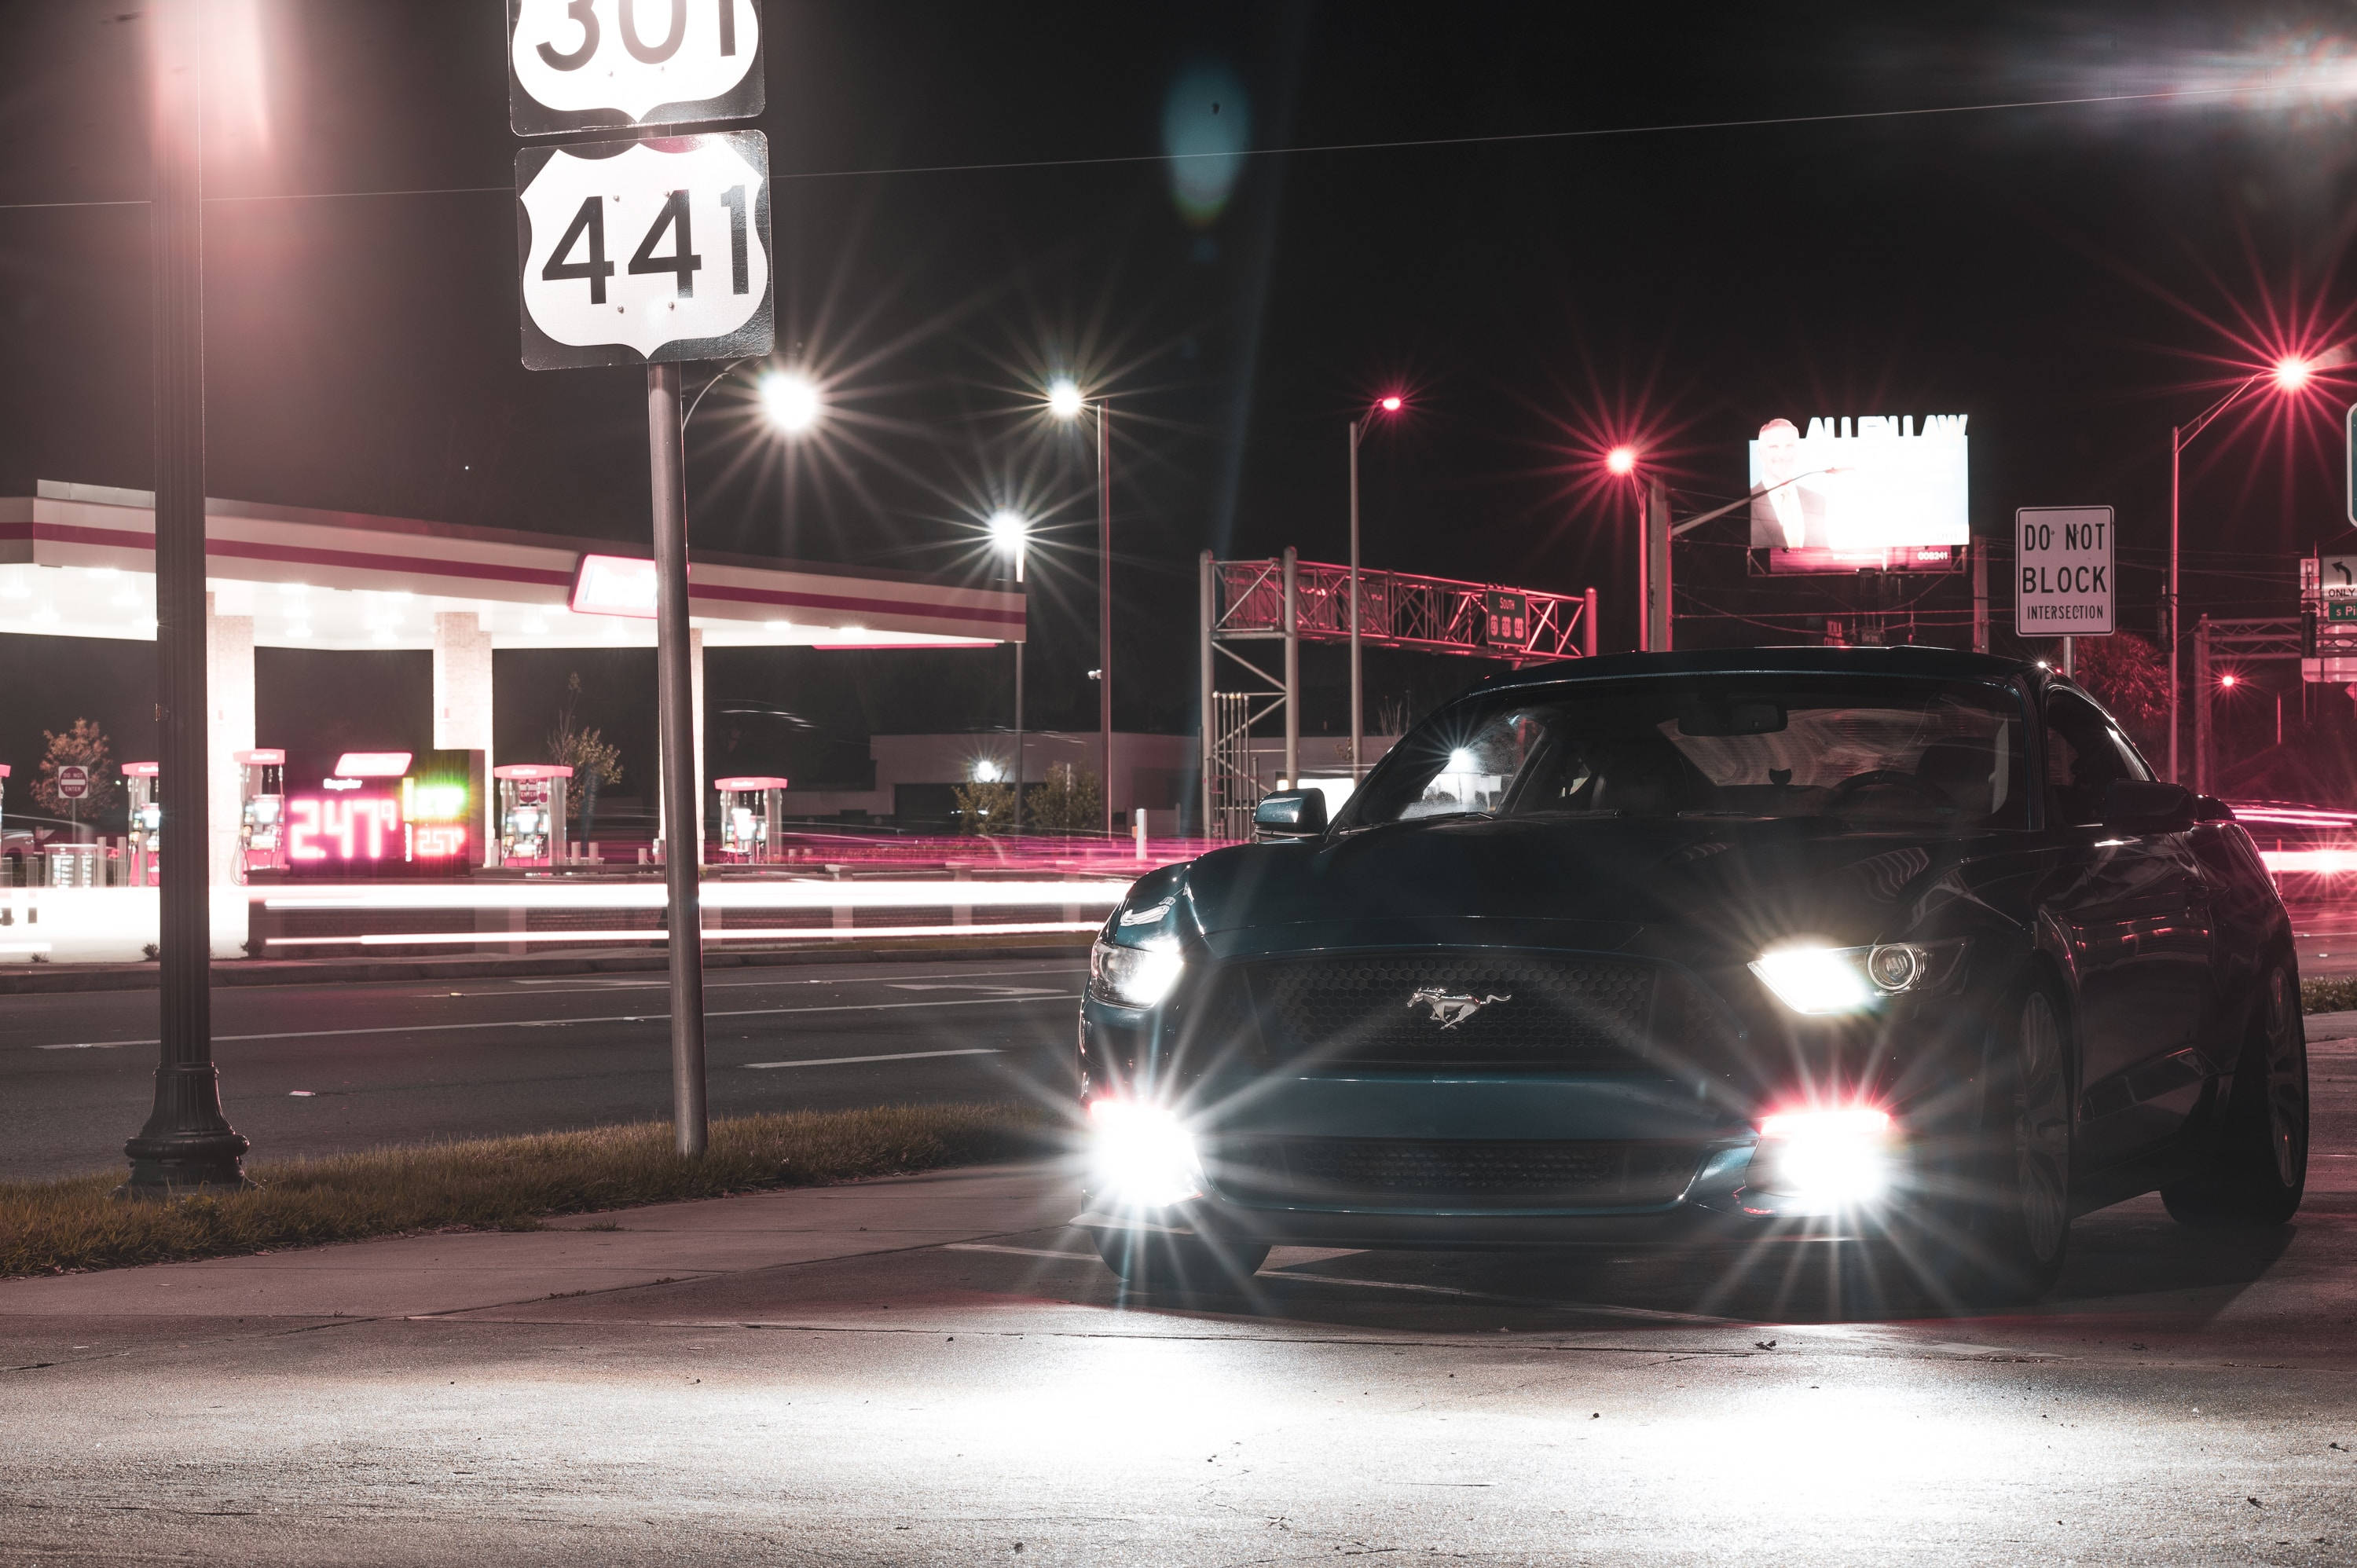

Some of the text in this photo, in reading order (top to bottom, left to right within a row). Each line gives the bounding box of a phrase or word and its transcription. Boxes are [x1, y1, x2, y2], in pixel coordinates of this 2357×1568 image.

[536, 0, 736, 71] 301
[542, 185, 750, 305] 441
[2025, 523, 2106, 551] DO NOT
[2022, 566, 2107, 594] BLOCK
[2328, 588, 2355, 598] ONLY
[2027, 605, 2104, 620] INTERSECTION
